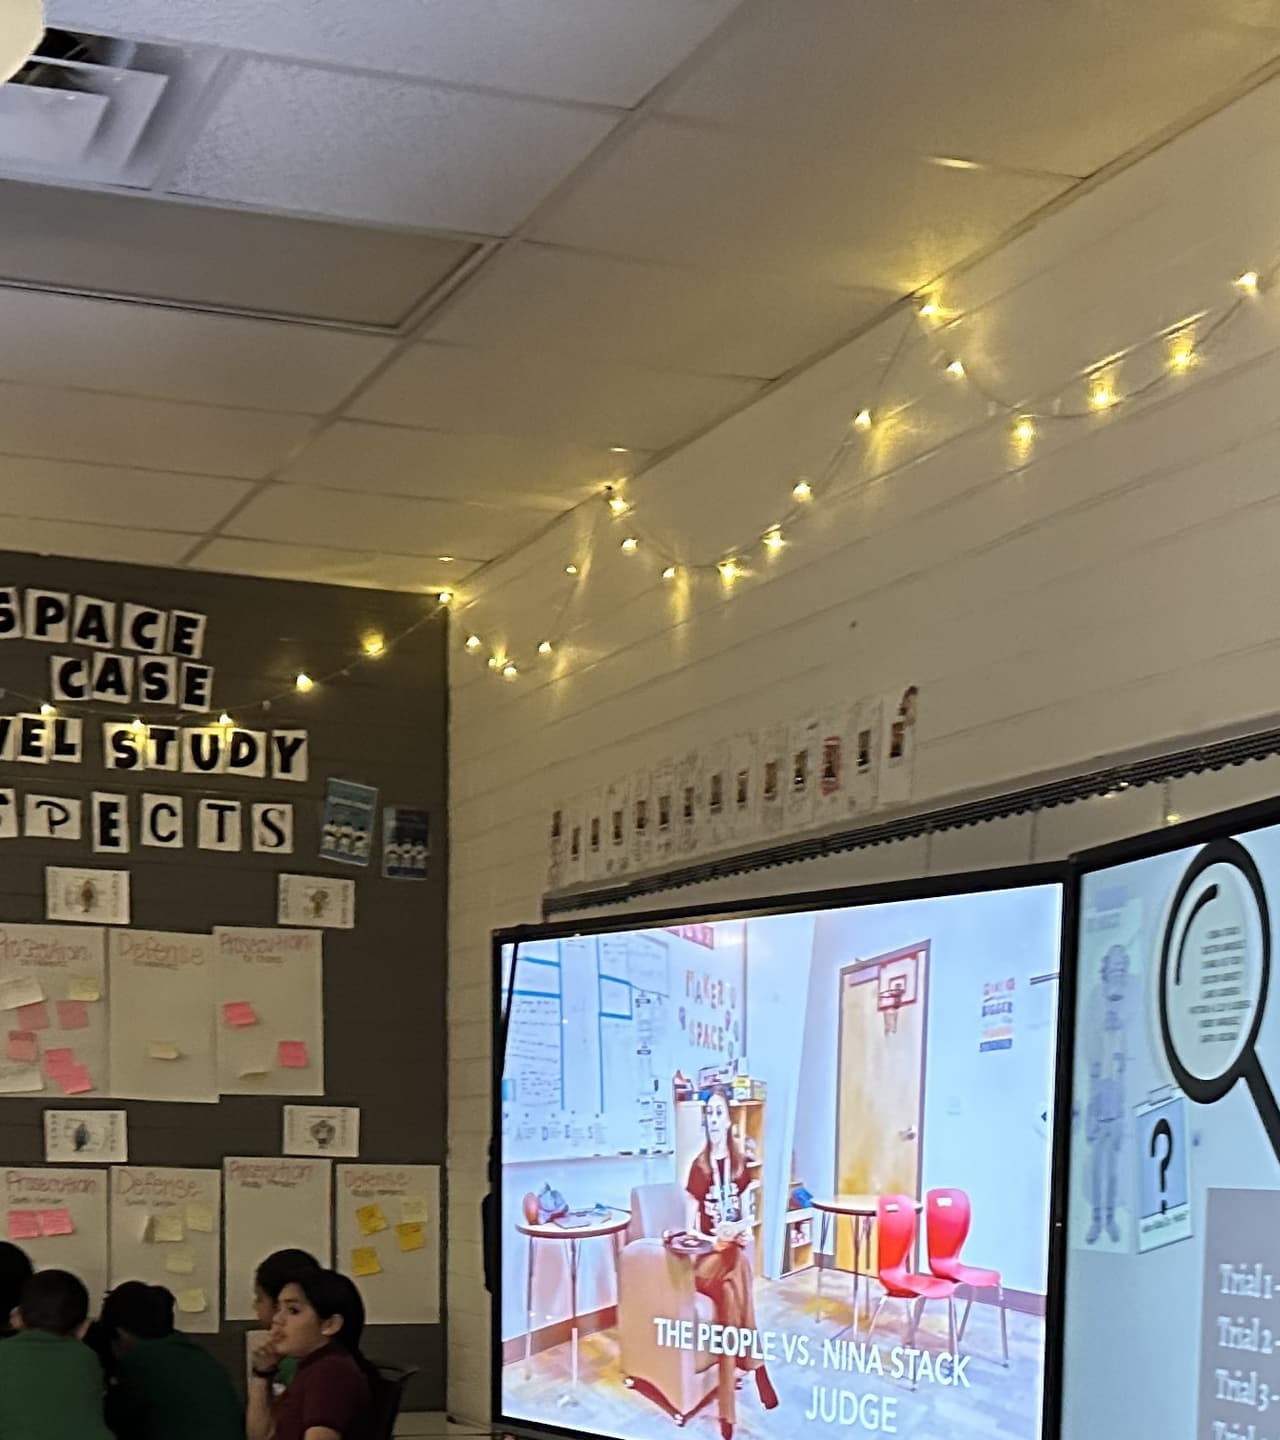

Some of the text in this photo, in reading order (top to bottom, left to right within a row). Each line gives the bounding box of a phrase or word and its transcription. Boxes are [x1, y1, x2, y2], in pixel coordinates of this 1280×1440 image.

[57, 658, 210, 708] CASE
[111, 728, 307, 775] STUDY
[1219, 1263, 1262, 1299] Trial
[653, 1317, 972, 1389] THE PEOPLE VS. NINA STACK
[1216, 1316, 1259, 1352] Trial
[1260, 1332, 1273, 1353] 2
[805, 1384, 898, 1433] JUDGE
[1215, 1369, 1258, 1405] Trial
[1258, 1385, 1270, 1412] 3
